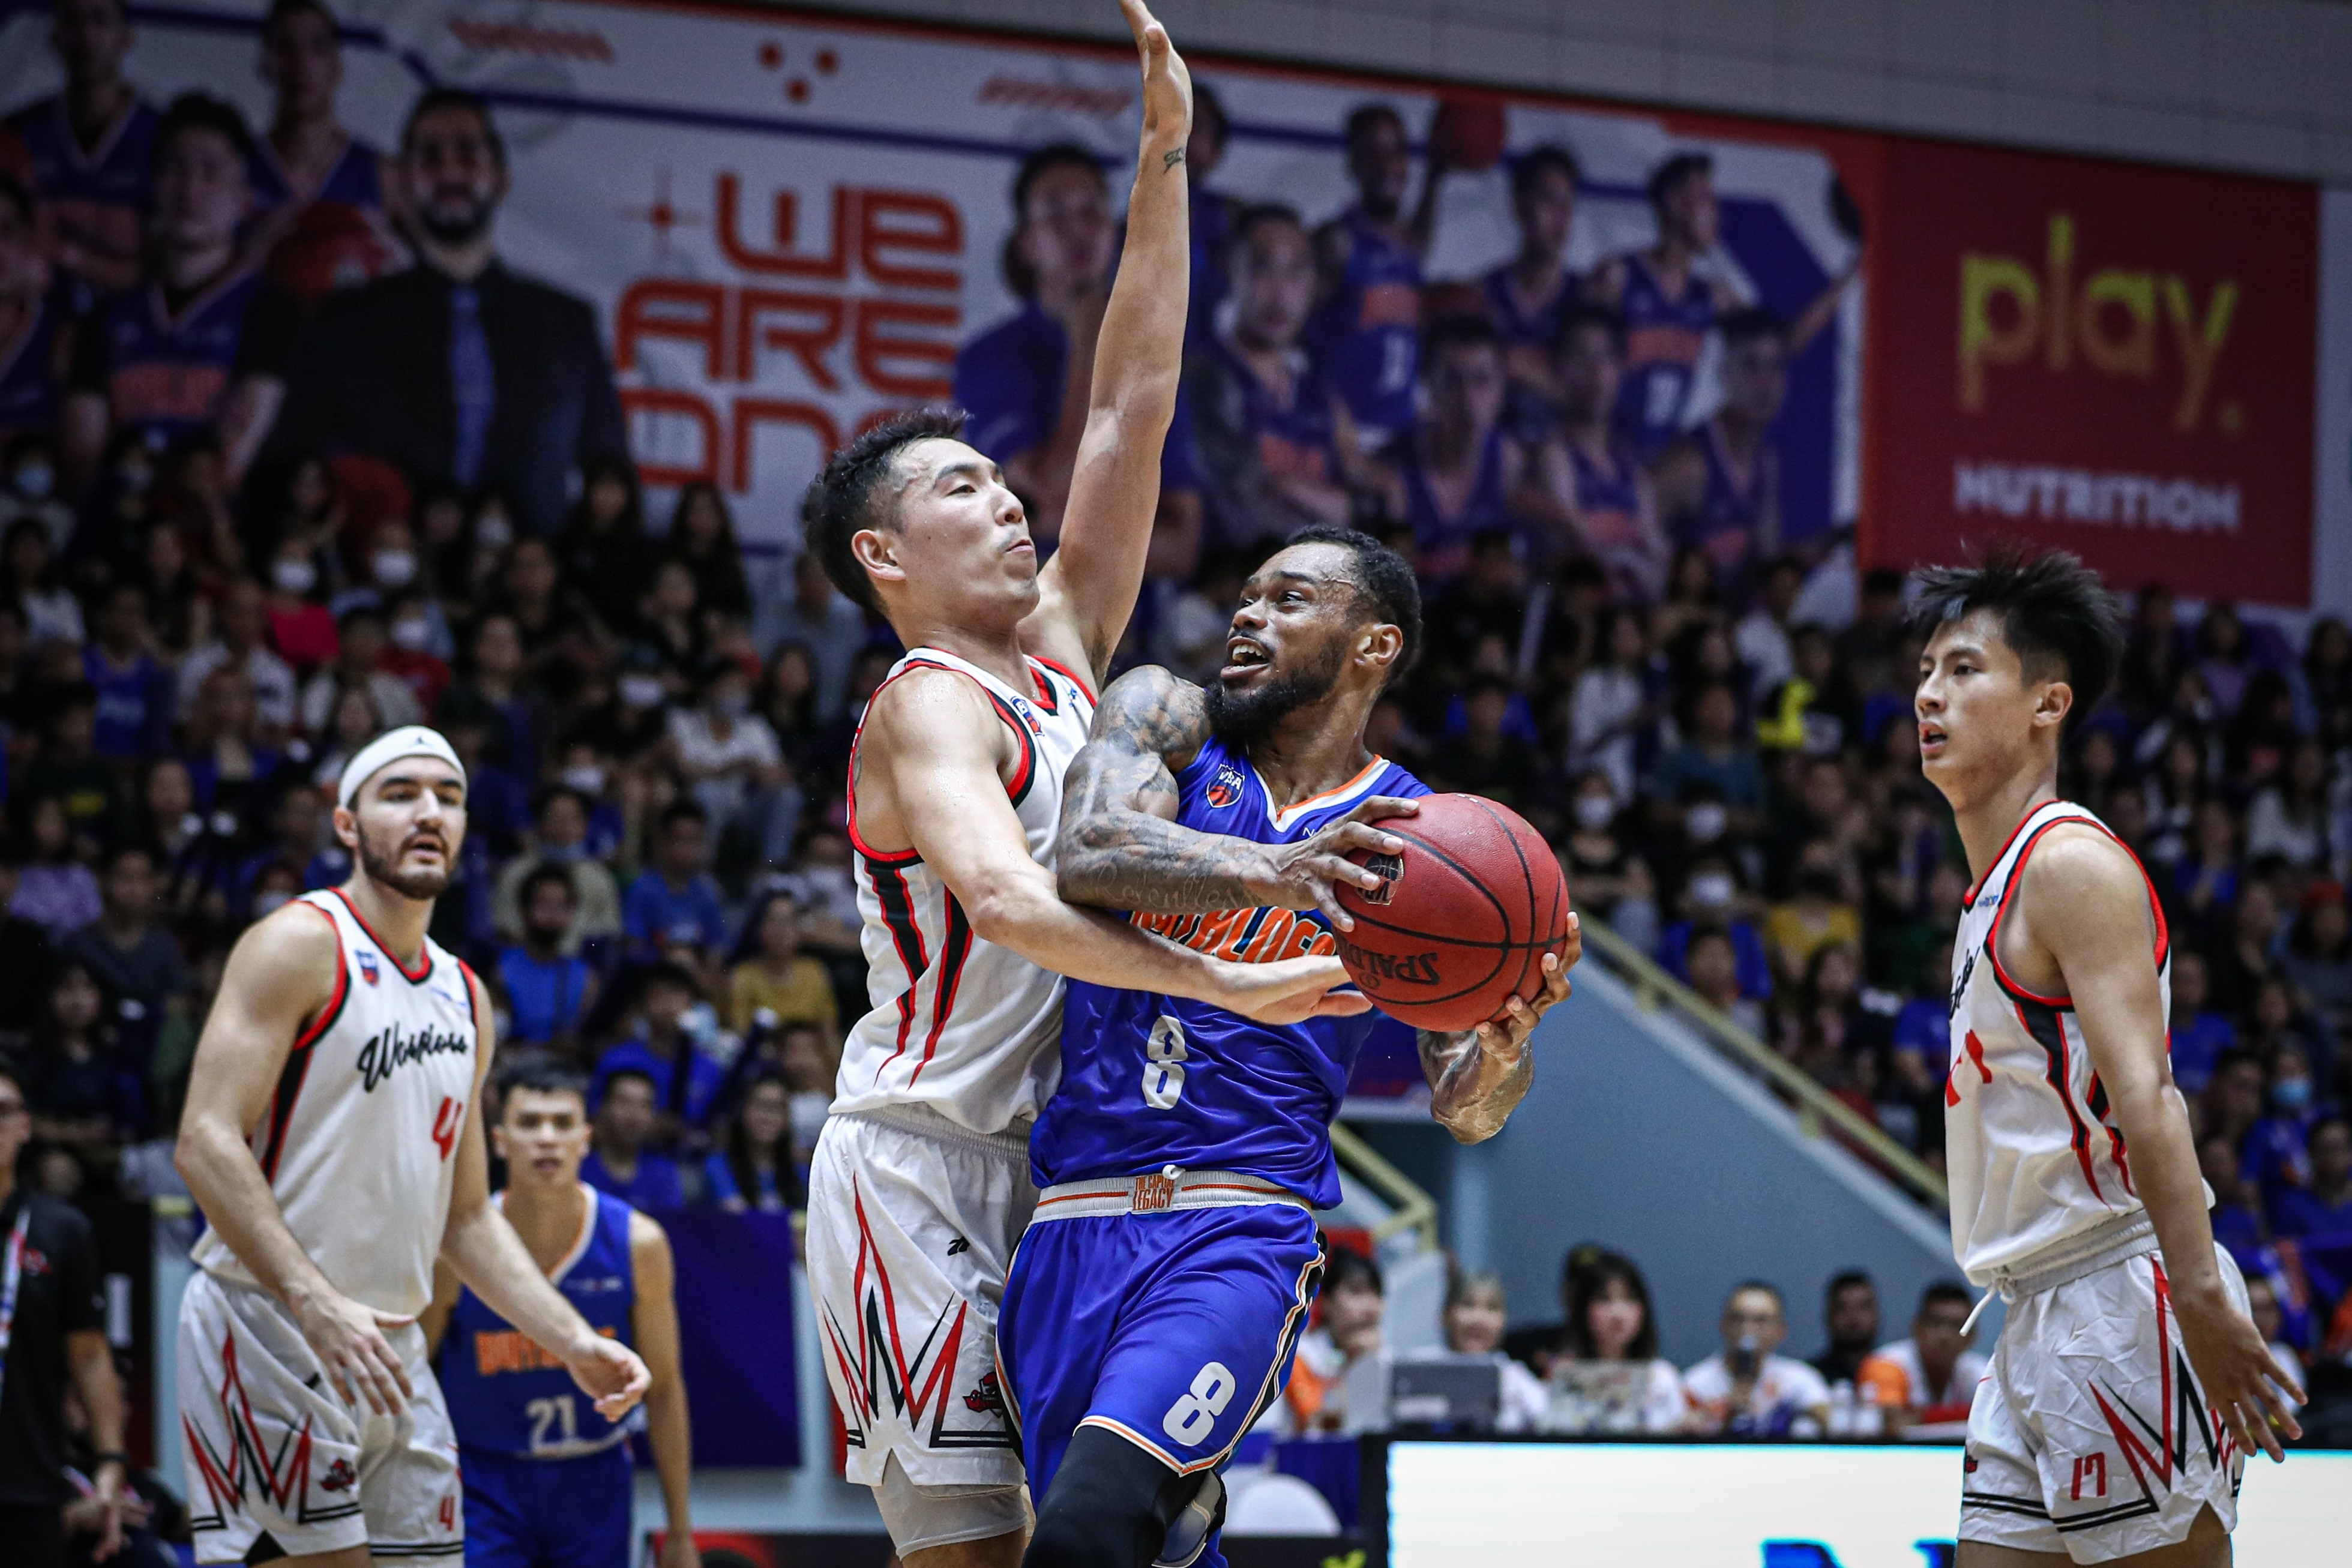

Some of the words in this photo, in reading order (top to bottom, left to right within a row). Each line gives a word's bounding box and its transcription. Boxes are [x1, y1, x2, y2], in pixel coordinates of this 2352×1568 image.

[614, 278, 961, 397] ARE
[619, 386, 900, 494] ON
[1953, 458, 2243, 535] NUTRITION
[1219, 771, 1242, 790] VBA
[1141, 1015, 1189, 1110] 8
[432, 1096, 463, 1162] 4
[1132, 1189, 1174, 1210] LEGACY
[526, 1395, 580, 1453] 21
[1162, 1361, 1236, 1447] 8
[2071, 1452, 2106, 1500] 17
[439, 1495, 455, 1531] 4
